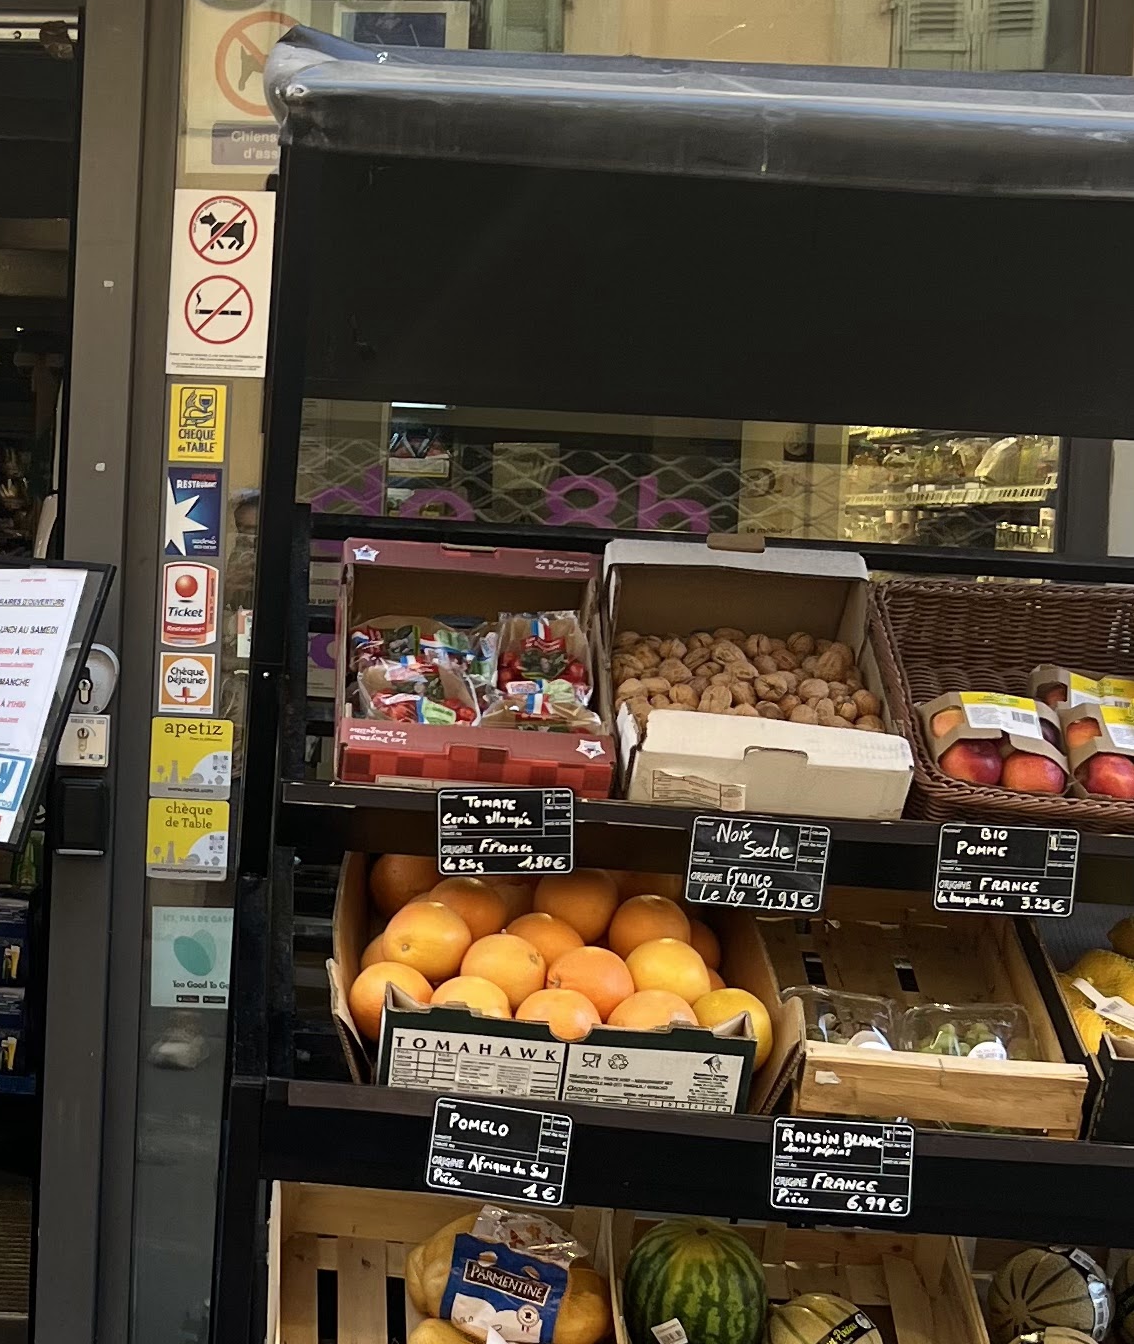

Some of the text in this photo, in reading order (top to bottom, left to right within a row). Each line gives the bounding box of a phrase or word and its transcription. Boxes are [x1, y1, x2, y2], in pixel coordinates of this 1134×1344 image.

[178, 429, 215, 442] CHEQUE
[186, 442, 215, 453] TABLE
[168, 606, 204, 618] Ticket
[170, 666, 204, 677] Chèque
[164, 721, 224, 738] apetiz
[165, 801, 213, 818] chèque
[462, 795, 517, 811] TOMATE
[165, 816, 213, 829] de Table
[980, 827, 1009, 841] BIO
[956, 840, 1008, 857] POMME
[726, 866, 773, 889] France
[979, 877, 1040, 893] FRANCE
[172, 980, 186, 988] Too
[186, 980, 208, 989] Good
[209, 981, 218, 989] To
[394, 1035, 558, 1061] TOMAHAWK
[449, 1112, 510, 1137] POMELO
[811, 1172, 879, 1193] FRANCE
[470, 1263, 544, 1300] PARMENTINE
